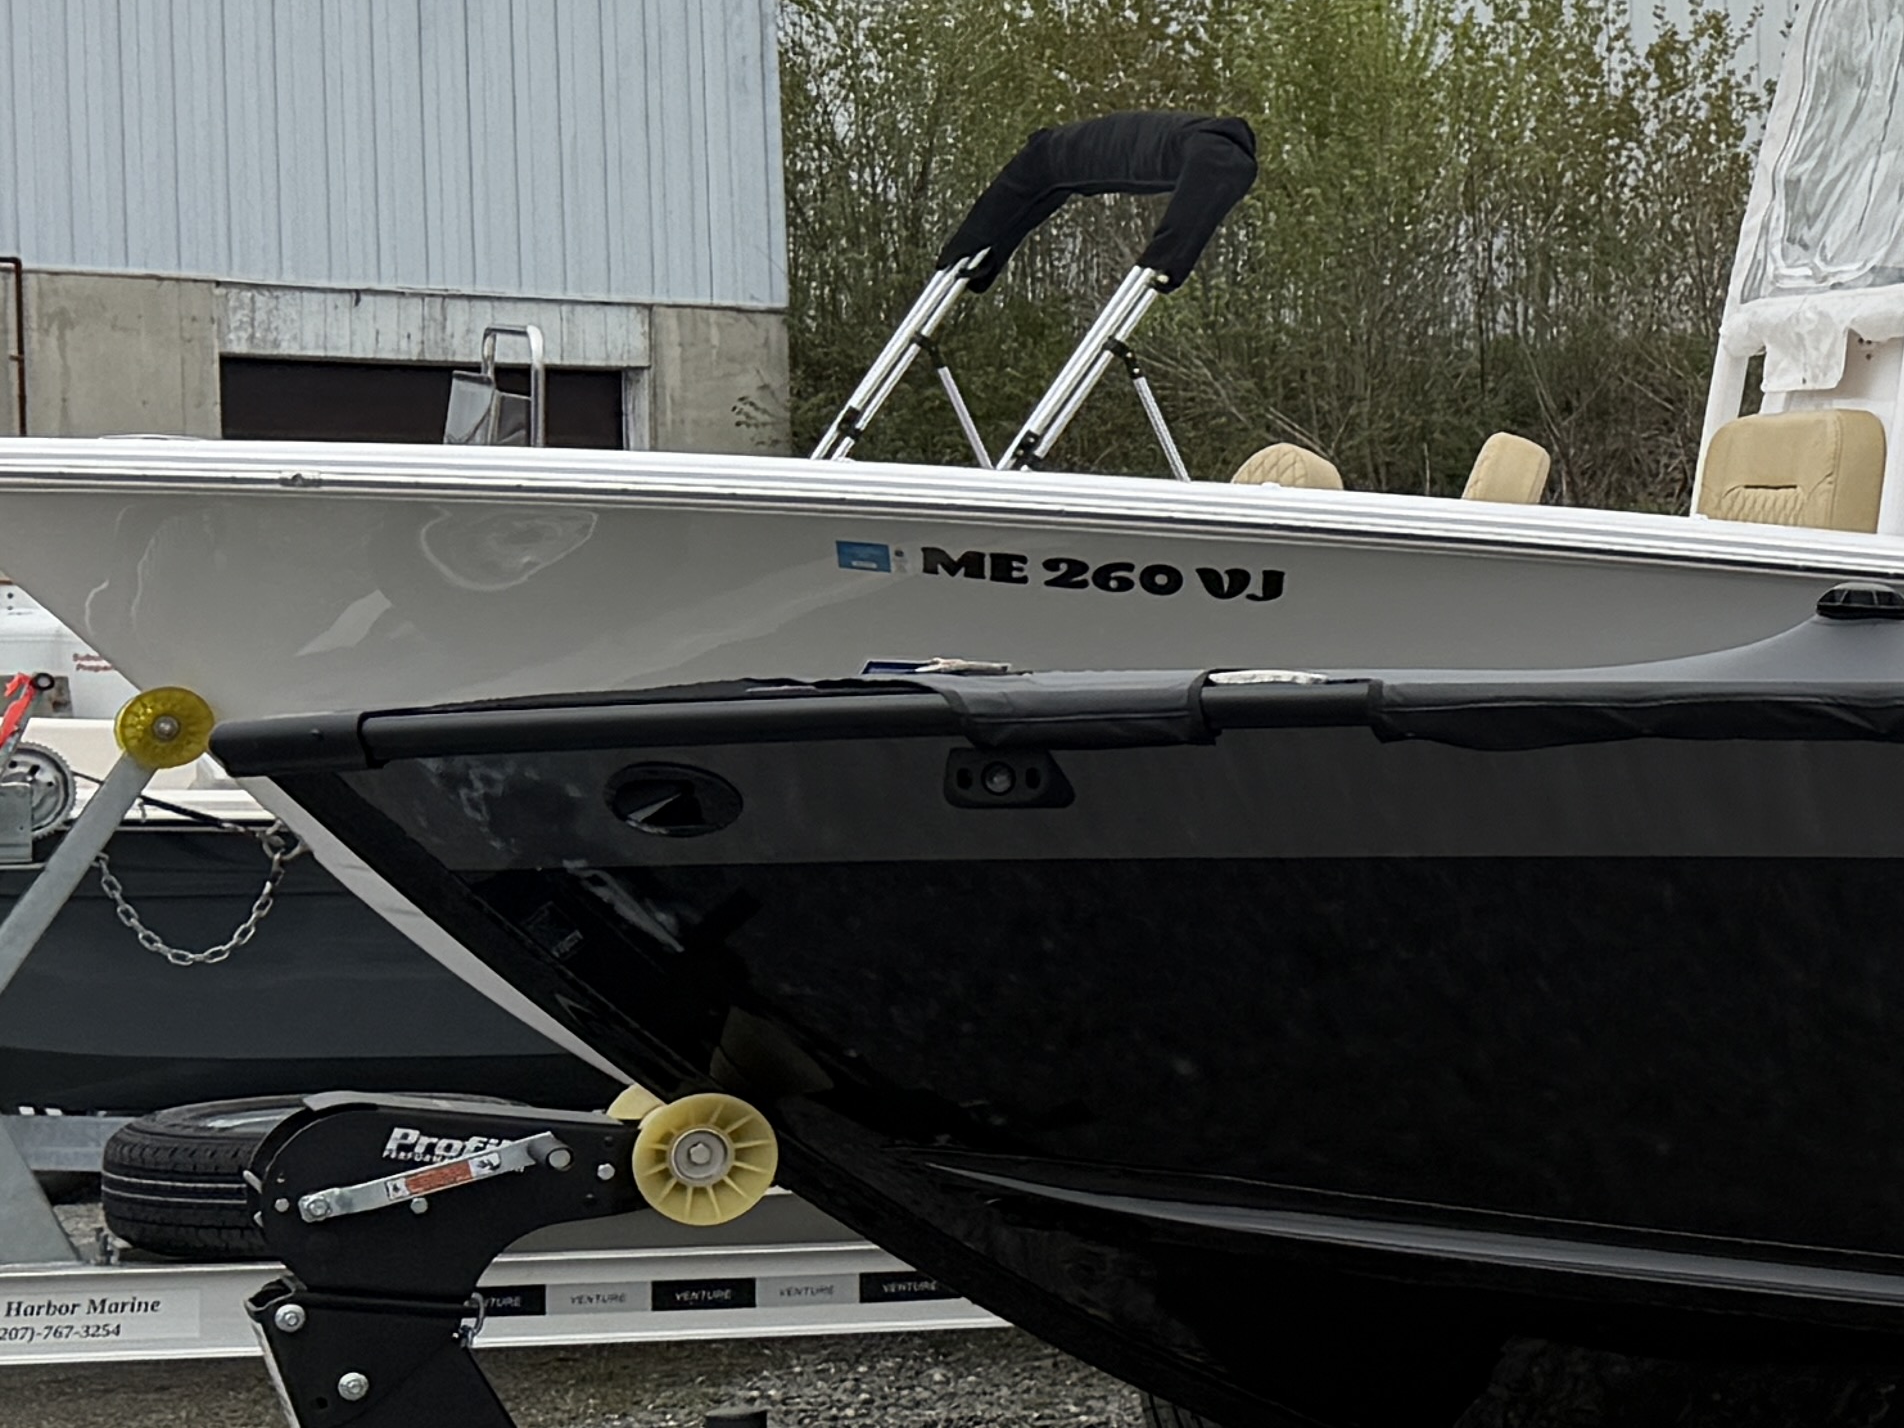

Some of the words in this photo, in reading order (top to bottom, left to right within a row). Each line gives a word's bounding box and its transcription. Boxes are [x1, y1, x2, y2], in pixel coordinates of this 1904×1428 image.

[921, 546, 1029, 585] ME
[1041, 557, 1184, 596] 260
[1195, 566, 1286, 602] VJ
[570, 1292, 627, 1306] VENTURE
[674, 1289, 733, 1302] VENTURE
[5, 1299, 81, 1318] Harbor
[86, 1296, 161, 1315] Marine
